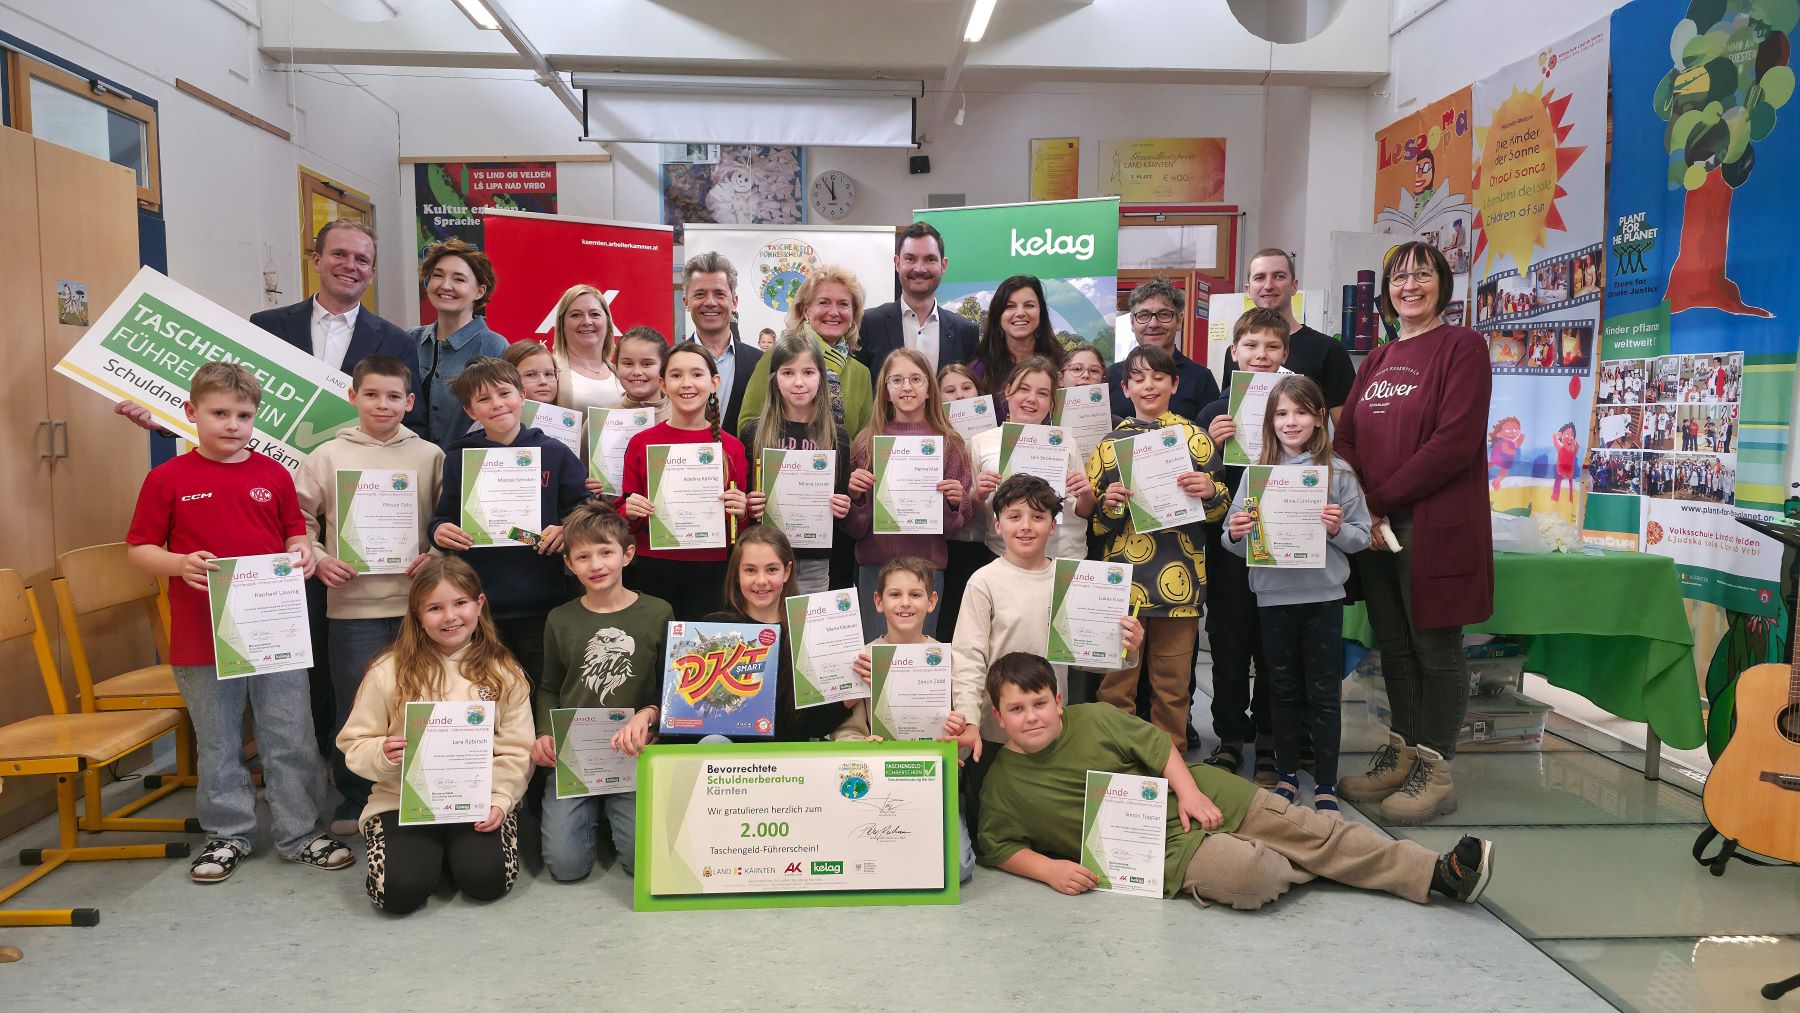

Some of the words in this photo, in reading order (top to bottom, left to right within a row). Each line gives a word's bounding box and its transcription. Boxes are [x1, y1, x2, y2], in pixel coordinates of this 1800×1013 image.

[1509, 128, 1540, 147] Kinder
[473, 171, 485, 179] VS
[487, 171, 505, 179] LIND
[486, 182, 503, 190] LIPA
[423, 203, 469, 215] Kultur
[433, 216, 481, 227] Sprache
[1619, 212, 1646, 226] PLANT
[1622, 223, 1640, 234] FOR
[1612, 235, 1622, 246] HE
[1623, 228, 1659, 243] PLANET
[1011, 228, 1095, 260] kelag
[326, 375, 347, 389] LAND
[263, 441, 300, 471] Kärn
[181, 487, 213, 502] CCM
[1669, 526, 1713, 539] Volksschule
[672, 640, 770, 705] DKT
[736, 662, 763, 674] SMART
[707, 764, 777, 774] Bevorrechtete
[707, 775, 805, 785] Schuldnerberatung
[707, 786, 748, 795] Kärnten
[707, 807, 722, 815] Wir
[724, 806, 769, 817] gratulieren
[771, 805, 803, 814] herzlich
[740, 821, 790, 838] 2.000
[710, 844, 819, 856] Taschengeld-Führerschein!
[744, 866, 776, 875] KÄRNTEN
[784, 862, 803, 873] AK
[813, 863, 841, 873] kelag
